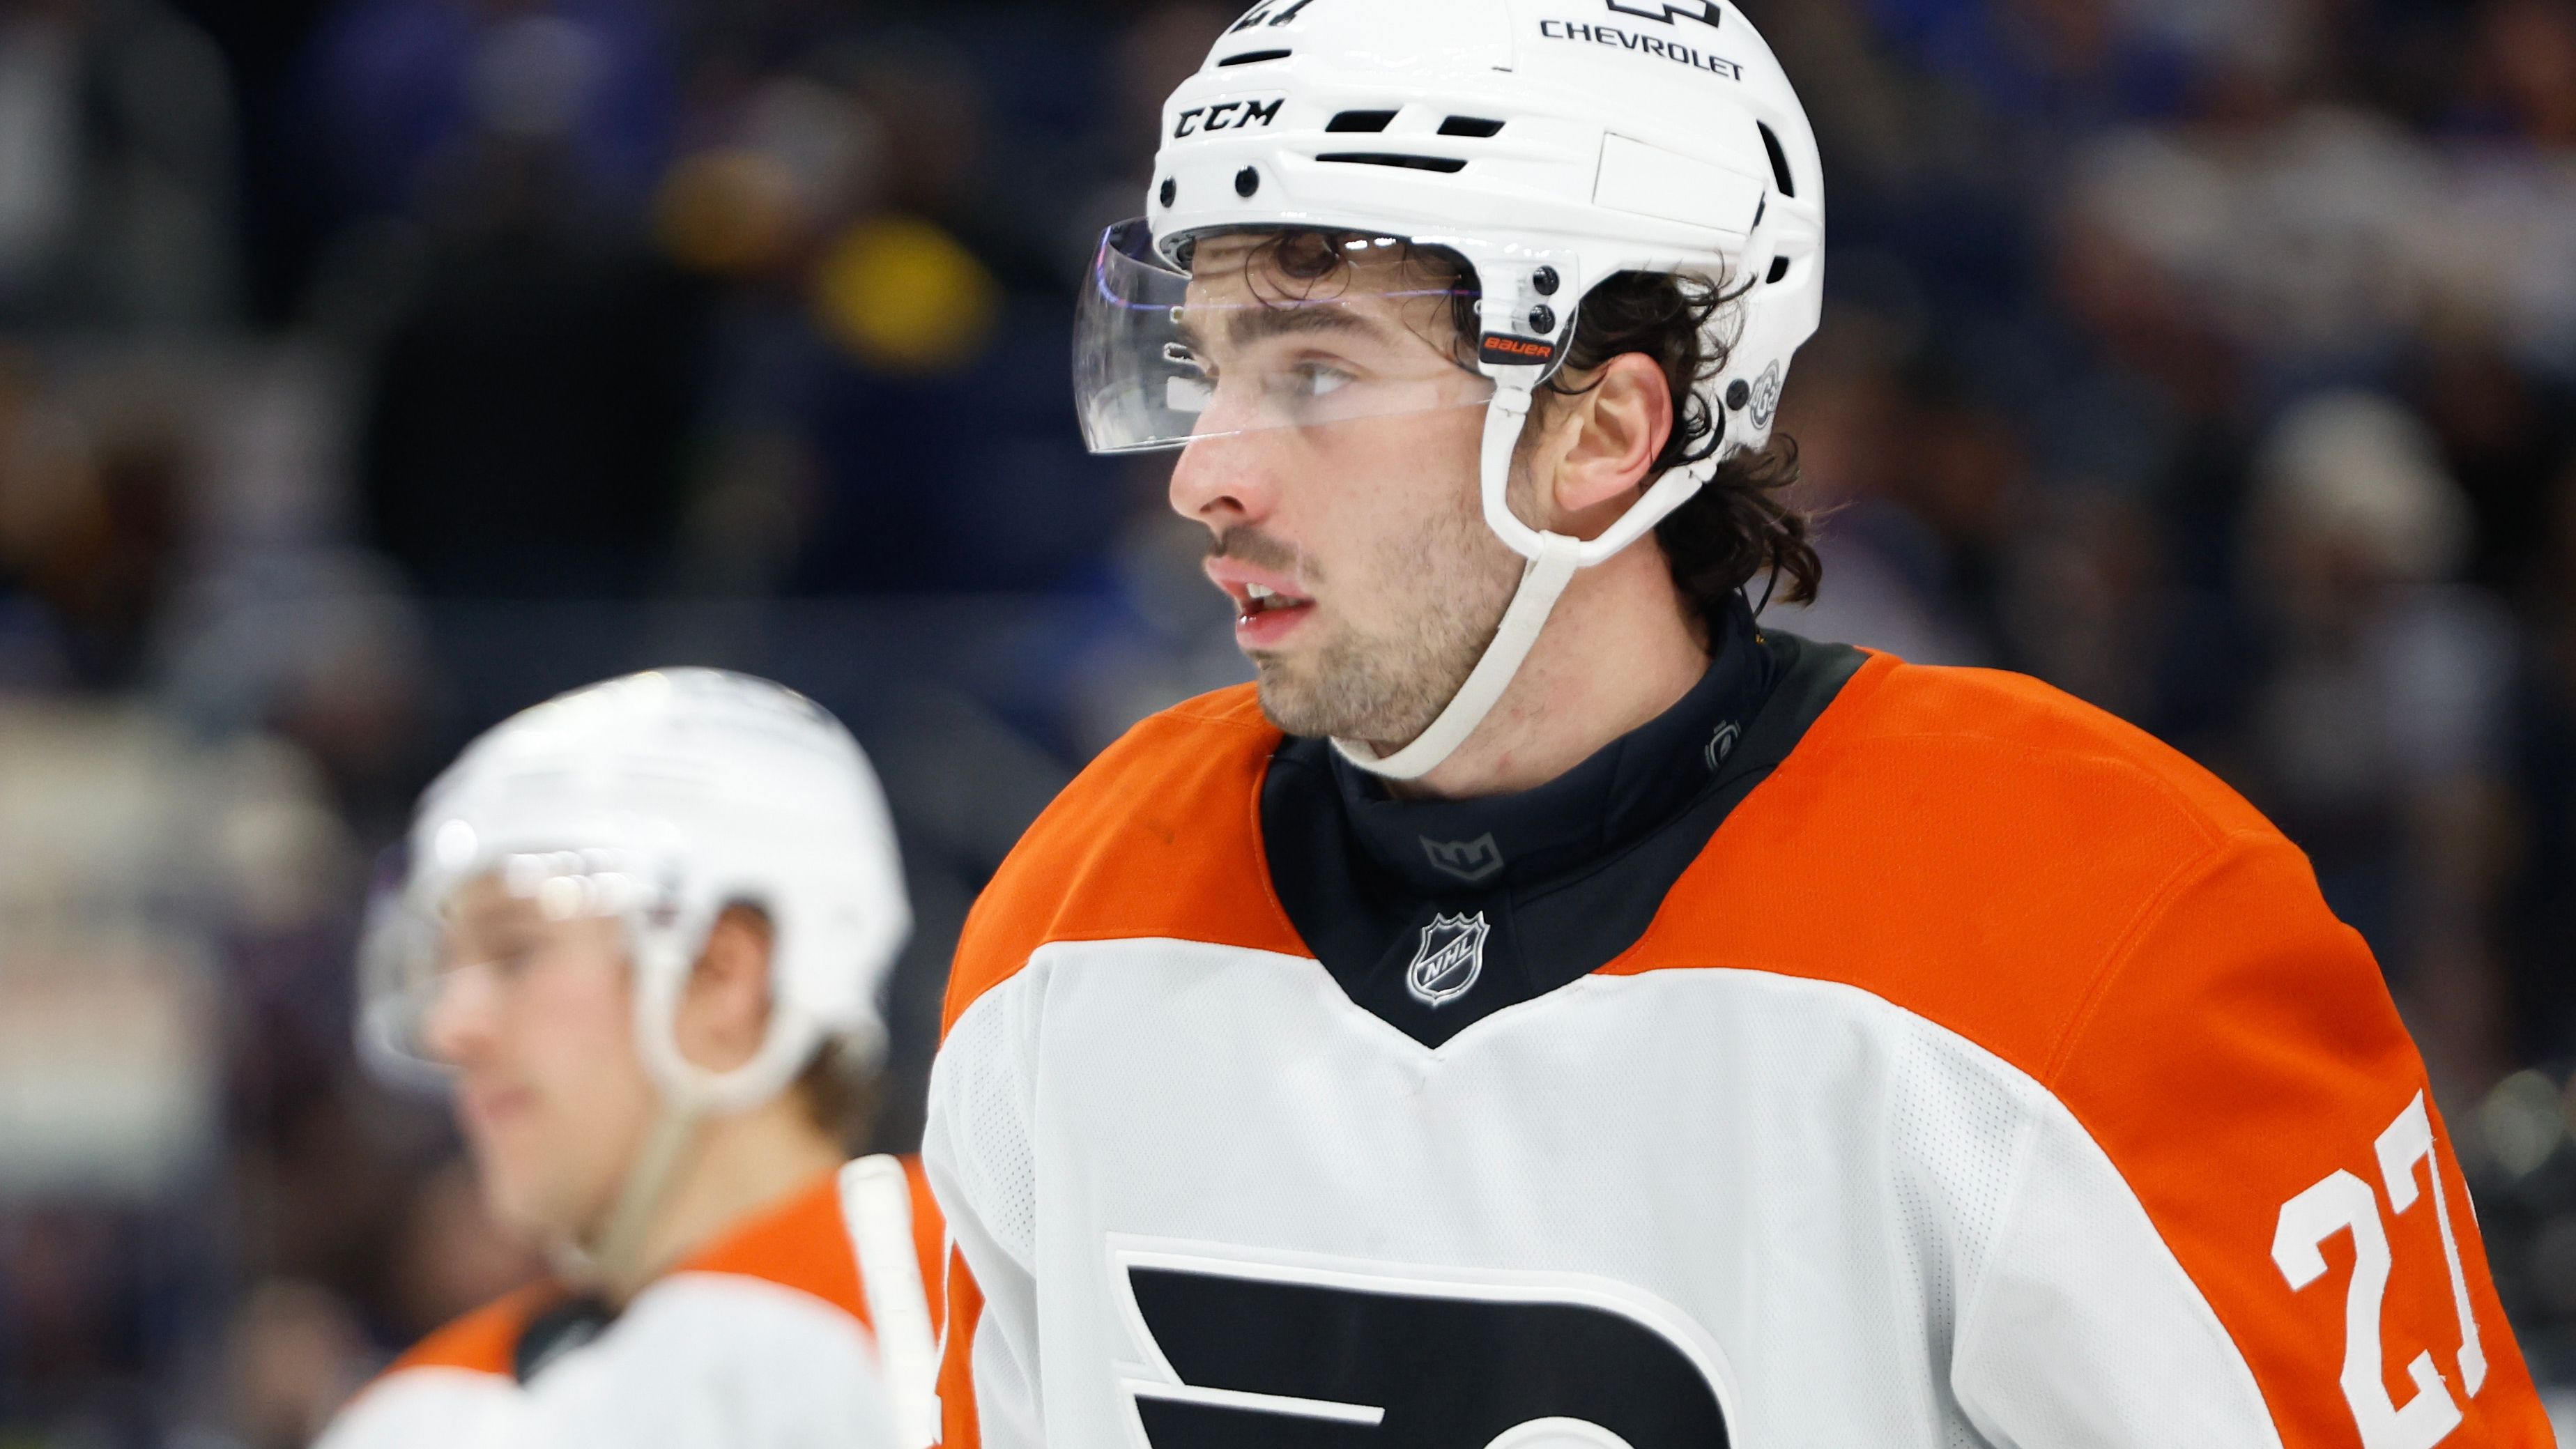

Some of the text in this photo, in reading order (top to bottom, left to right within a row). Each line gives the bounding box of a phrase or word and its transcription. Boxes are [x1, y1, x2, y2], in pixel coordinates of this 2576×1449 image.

[1540, 20, 1744, 82] CHEVROLET
[1174, 98, 1286, 139] CCM
[1423, 937, 1472, 983] NHL
[2271, 1087, 2488, 1449] 27
